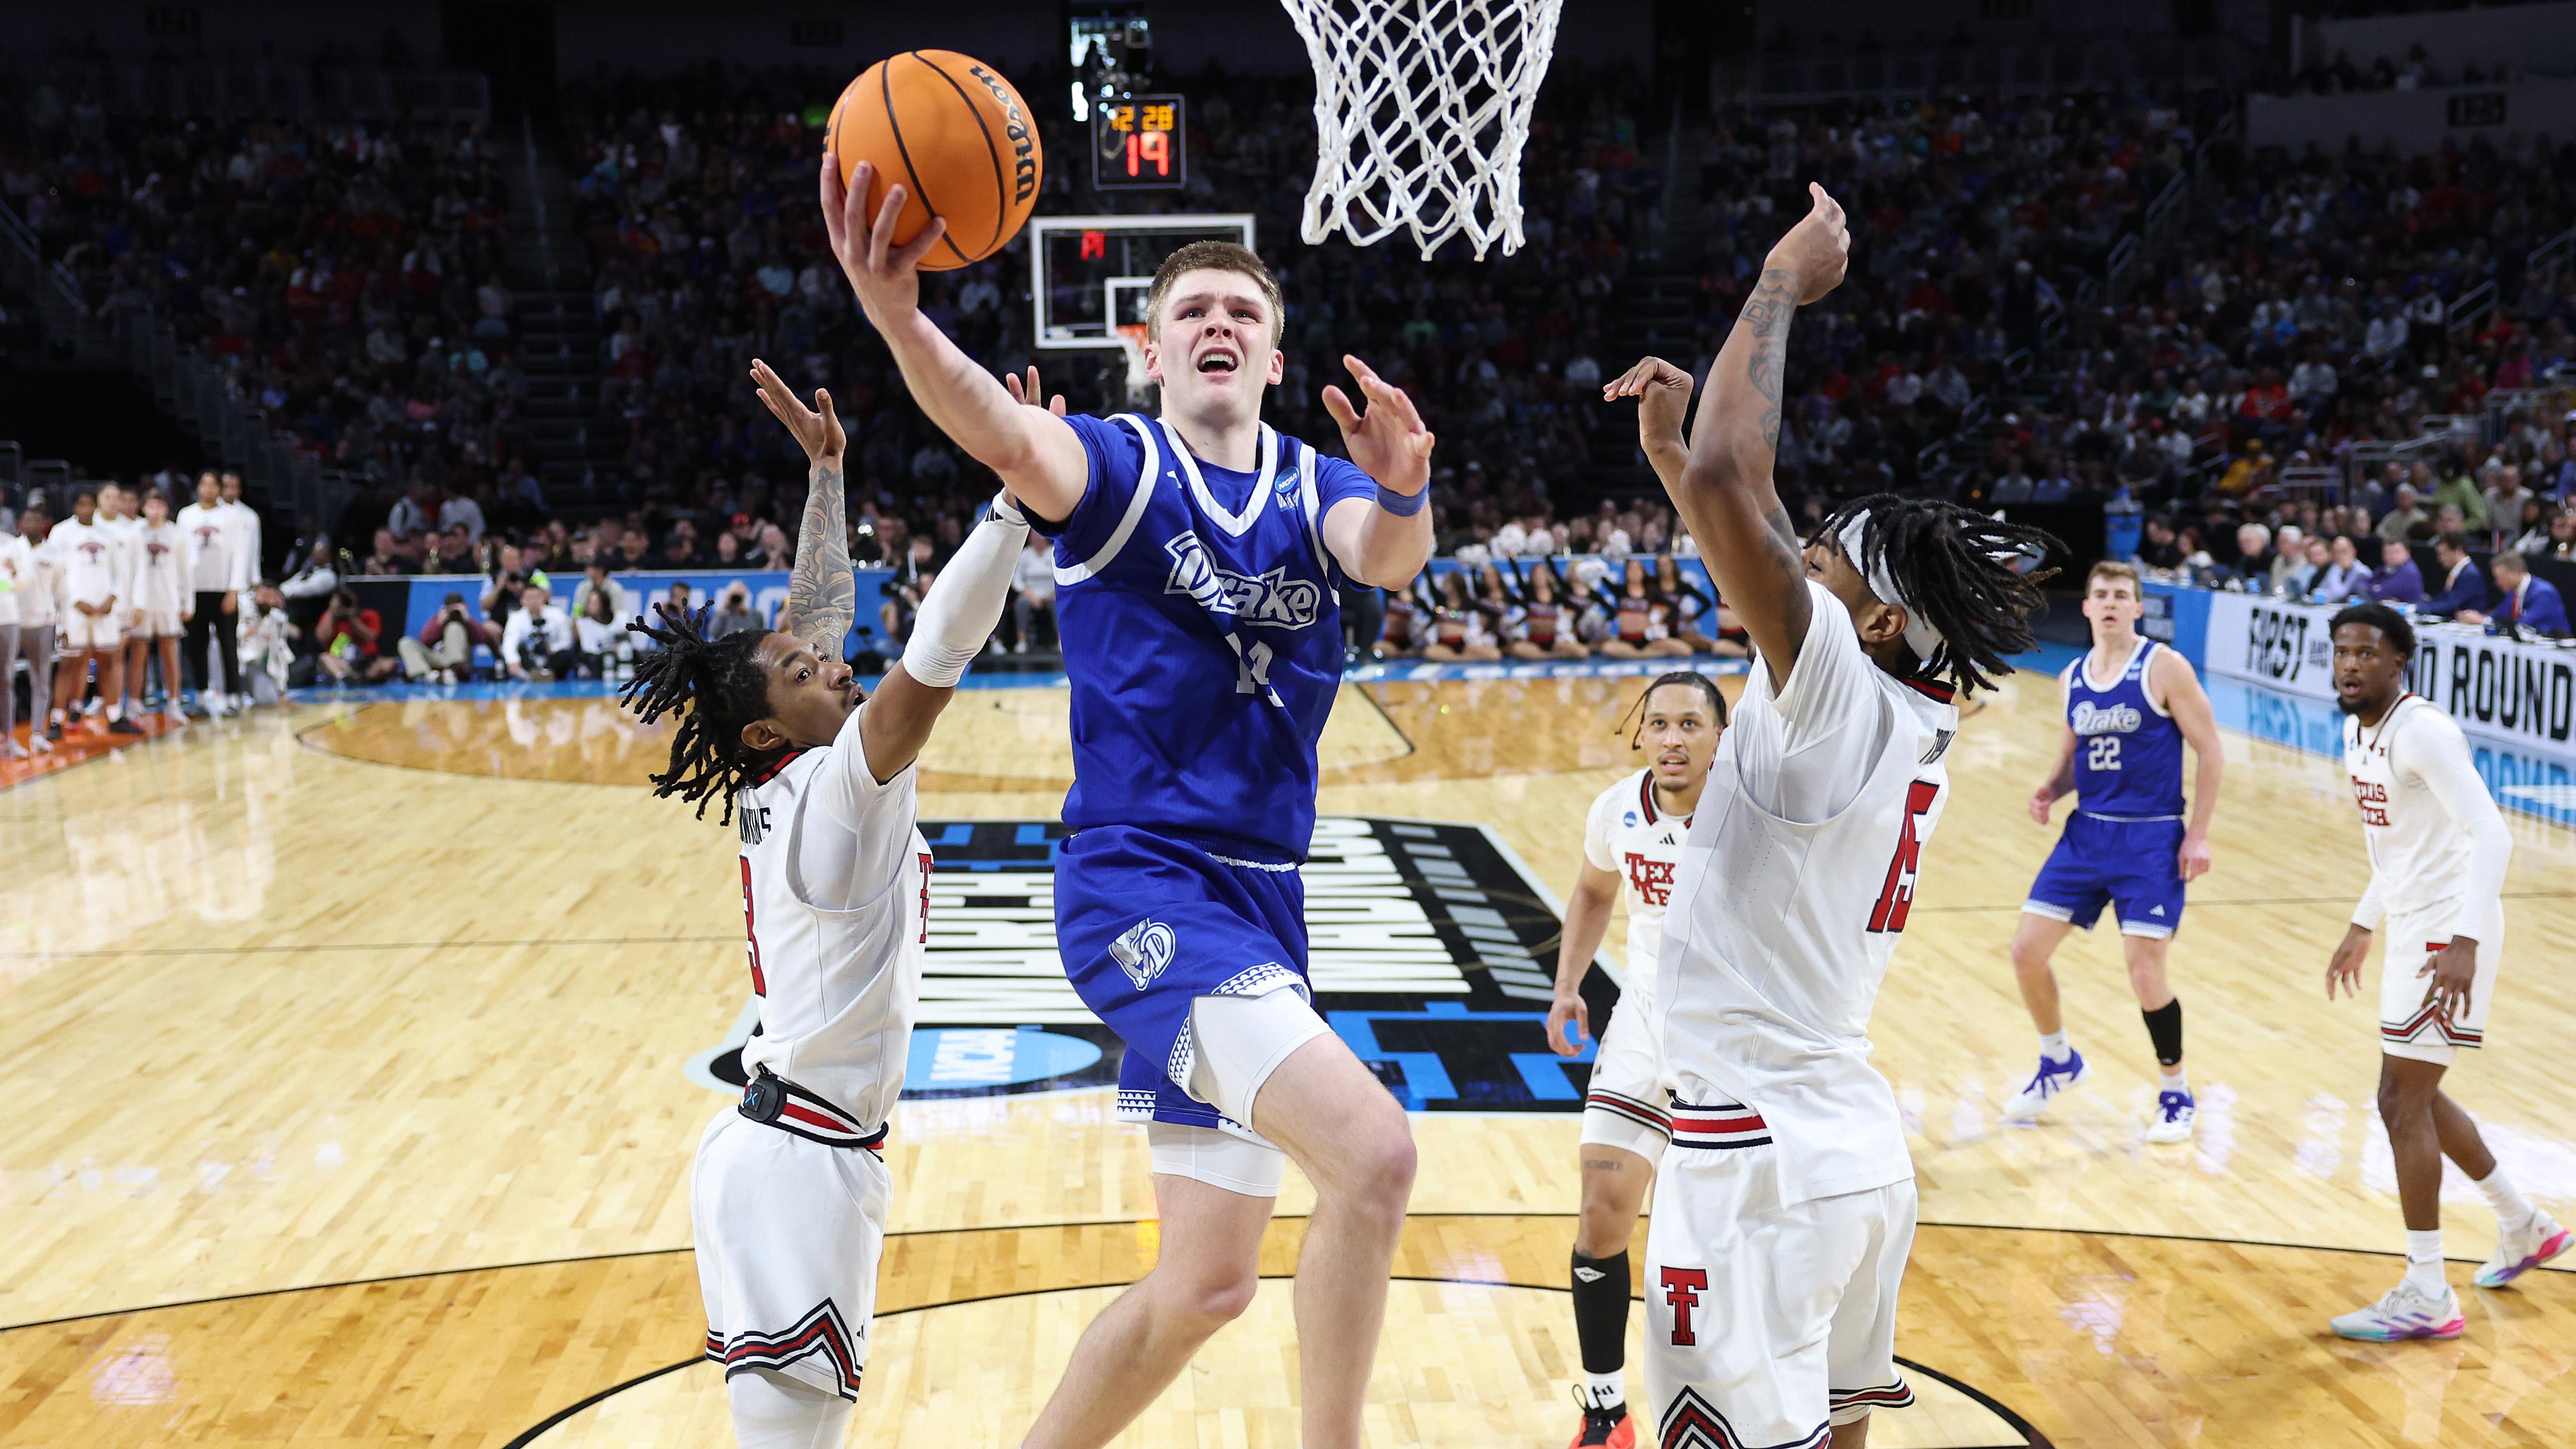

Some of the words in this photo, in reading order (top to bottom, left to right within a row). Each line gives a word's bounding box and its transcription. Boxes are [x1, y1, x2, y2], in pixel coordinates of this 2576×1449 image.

[1127, 132, 1169, 177] 19
[1278, 472, 1298, 490] NCAA
[2072, 700, 2142, 736] Drake
[2088, 736, 2123, 771] 22
[1625, 851, 1675, 884] TEX
[1866, 779, 1939, 933] 15
[1632, 881, 1670, 906] TE
[930, 1029, 1018, 1082] NCAA
